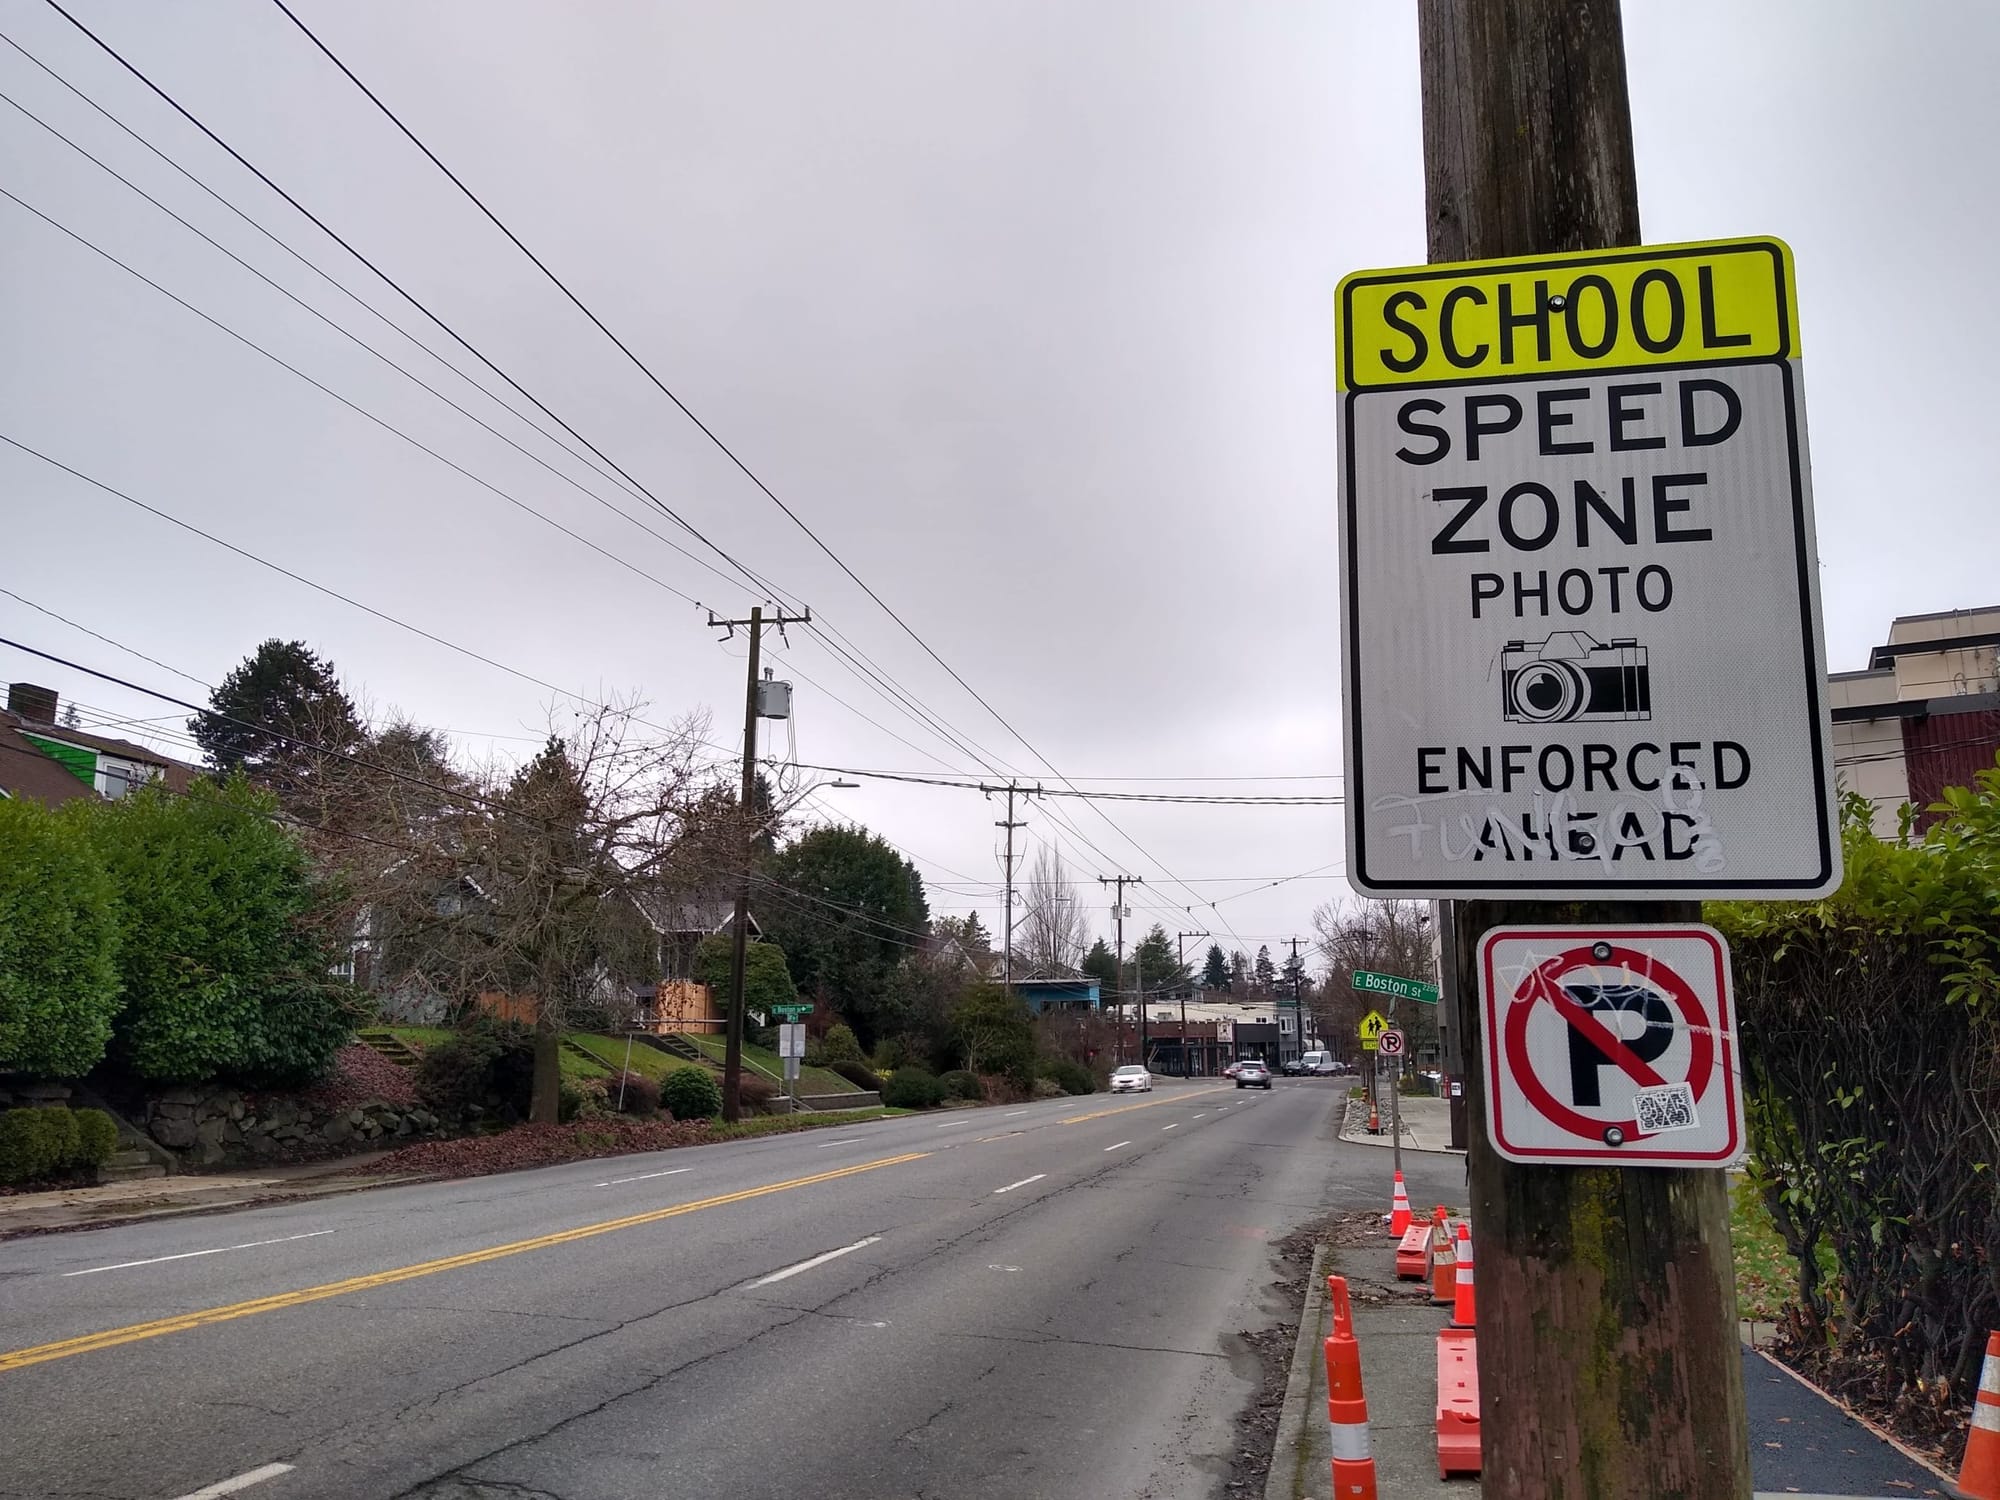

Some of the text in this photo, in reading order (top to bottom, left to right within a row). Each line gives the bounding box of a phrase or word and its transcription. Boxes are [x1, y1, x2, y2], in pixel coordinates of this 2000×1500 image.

[1379, 265, 1752, 374] SCHOOL
[1394, 379, 1743, 466] SPEED
[1431, 472, 1713, 555] ZONE
[1471, 564, 1674, 619] PHOTO
[1417, 740, 1751, 794] ENFORCED
[1473, 812, 1697, 862] AHEAD
[1355, 974, 1422, 998] E Boston St
